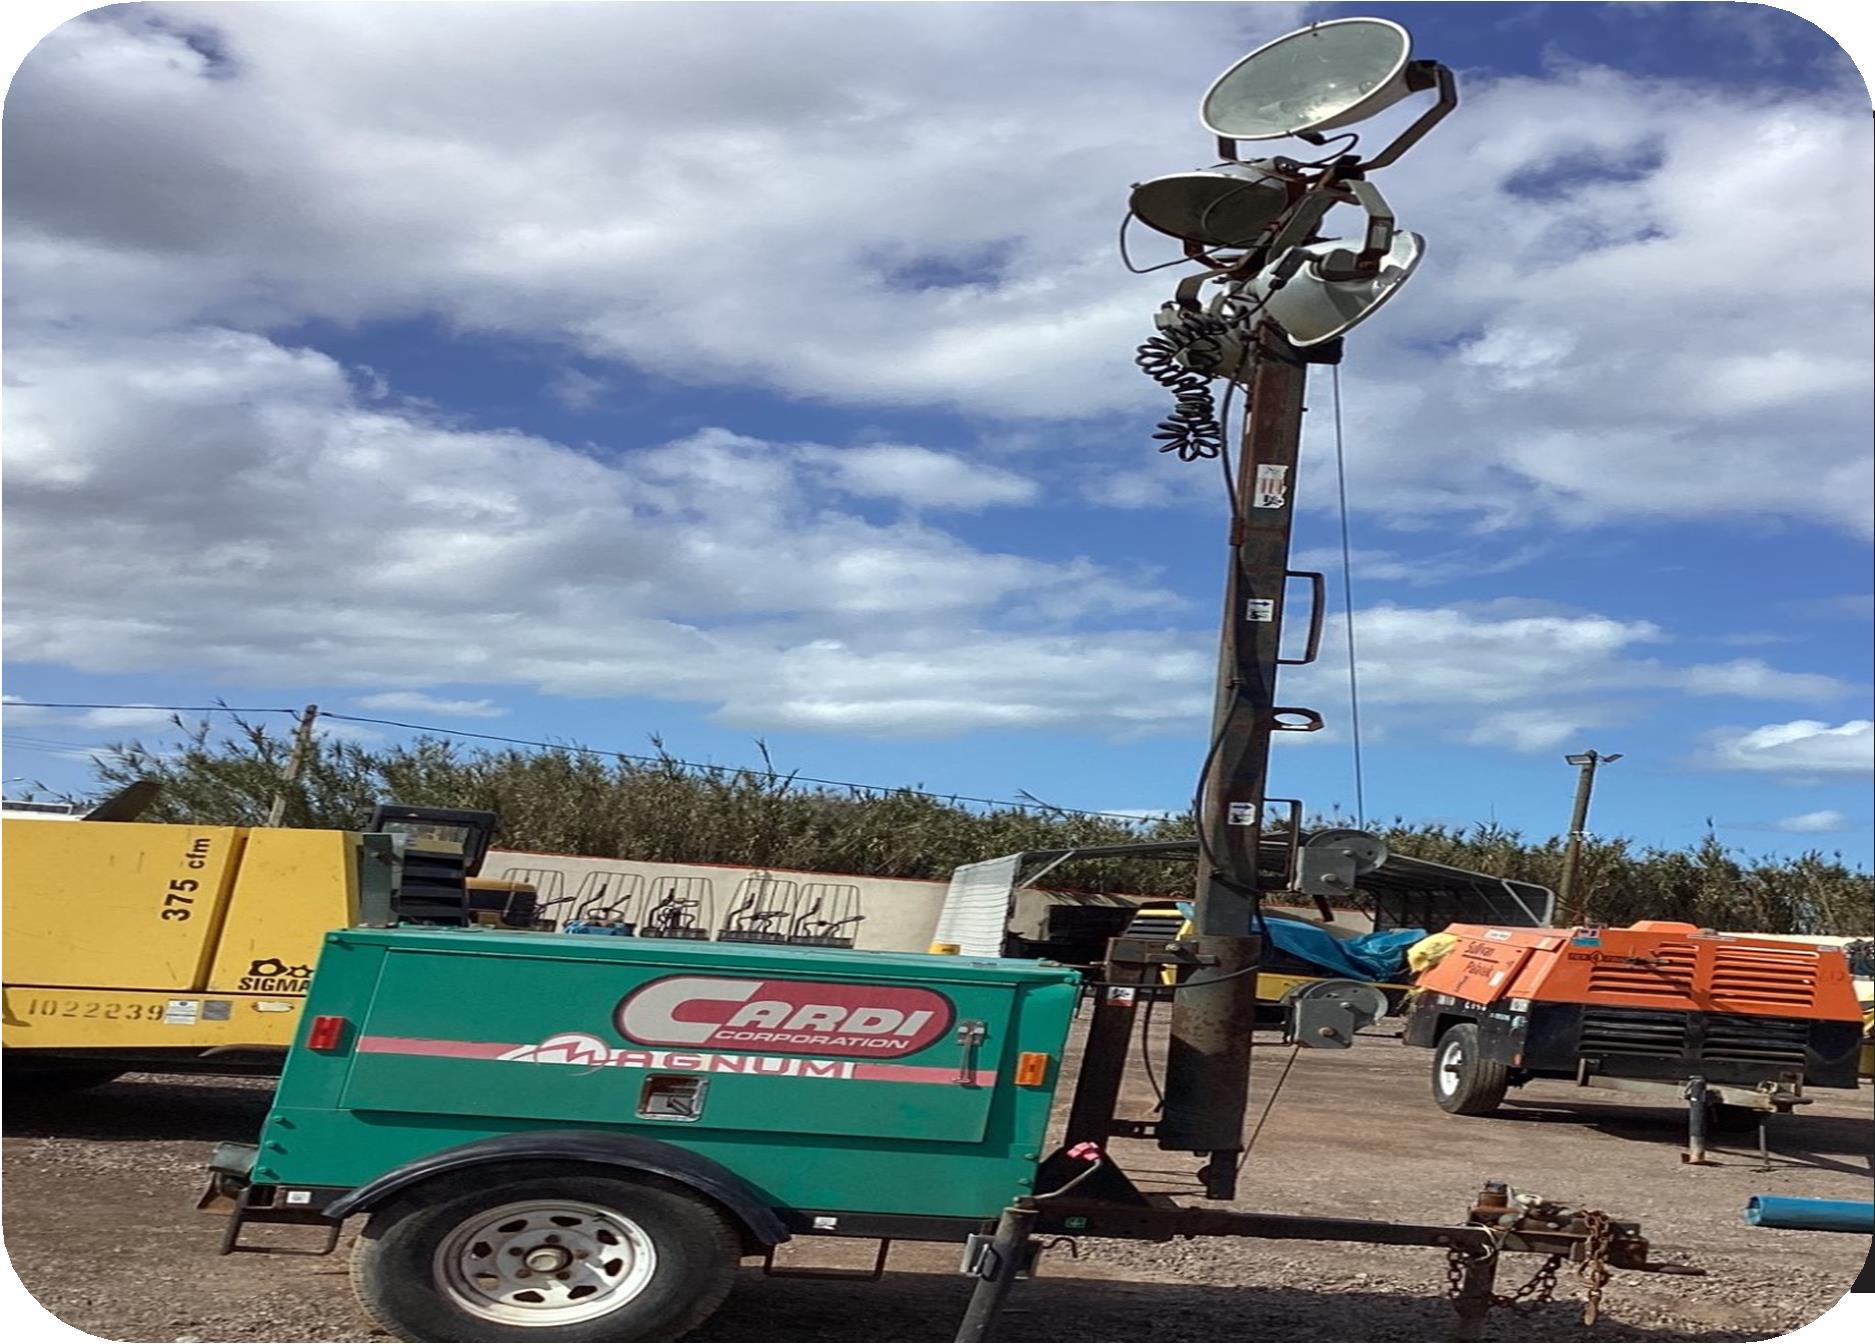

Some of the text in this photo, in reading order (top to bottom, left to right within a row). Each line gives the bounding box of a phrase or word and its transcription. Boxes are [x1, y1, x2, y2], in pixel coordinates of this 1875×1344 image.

[161, 838, 211, 921] 375 cfm
[238, 977, 310, 992] SIGMA
[28, 999, 165, 1020] 1022239
[621, 976, 934, 1041] CARDI
[508, 1033, 854, 1078] MAGNUM
[714, 1030, 909, 1049] CORPORATION
